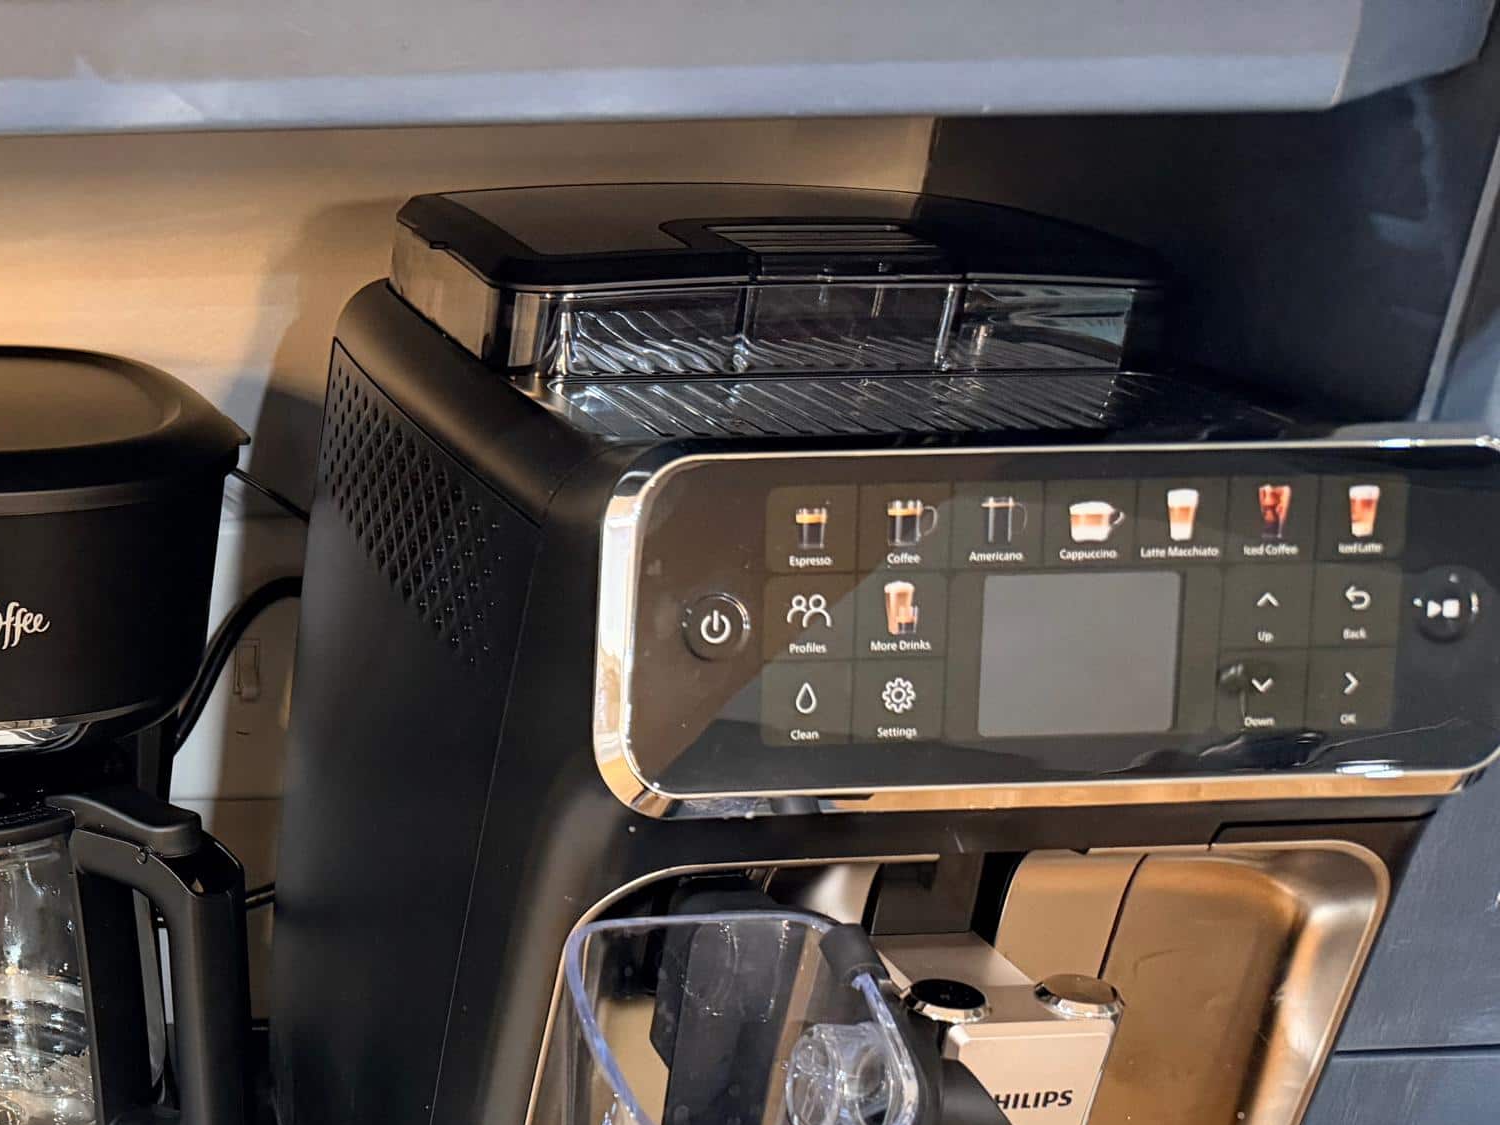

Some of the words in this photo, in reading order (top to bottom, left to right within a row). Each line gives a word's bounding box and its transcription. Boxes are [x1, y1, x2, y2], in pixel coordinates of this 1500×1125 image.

[1140, 547, 1165, 558] Latte
[1167, 546, 1219, 557] Macchiato
[1244, 545, 1263, 556] Iced
[1265, 544, 1298, 556] Coffee
[1358, 542, 1382, 553] Latte
[887, 553, 921, 565] Coffee
[969, 550, 1023, 562] Americano
[1059, 548, 1117, 561] Cappuccino
[789, 555, 832, 568] Espresso
[1257, 631, 1274, 643] Up
[1343, 628, 1367, 640] Back
[789, 642, 827, 653] Profiles
[870, 640, 897, 651] More
[899, 639, 931, 651] Drinks
[1244, 716, 1274, 727] Down
[1340, 714, 1356, 725] OK
[790, 729, 819, 740] Clean
[877, 725, 918, 738] Settings
[993, 1090, 1073, 1109] HILIPS
